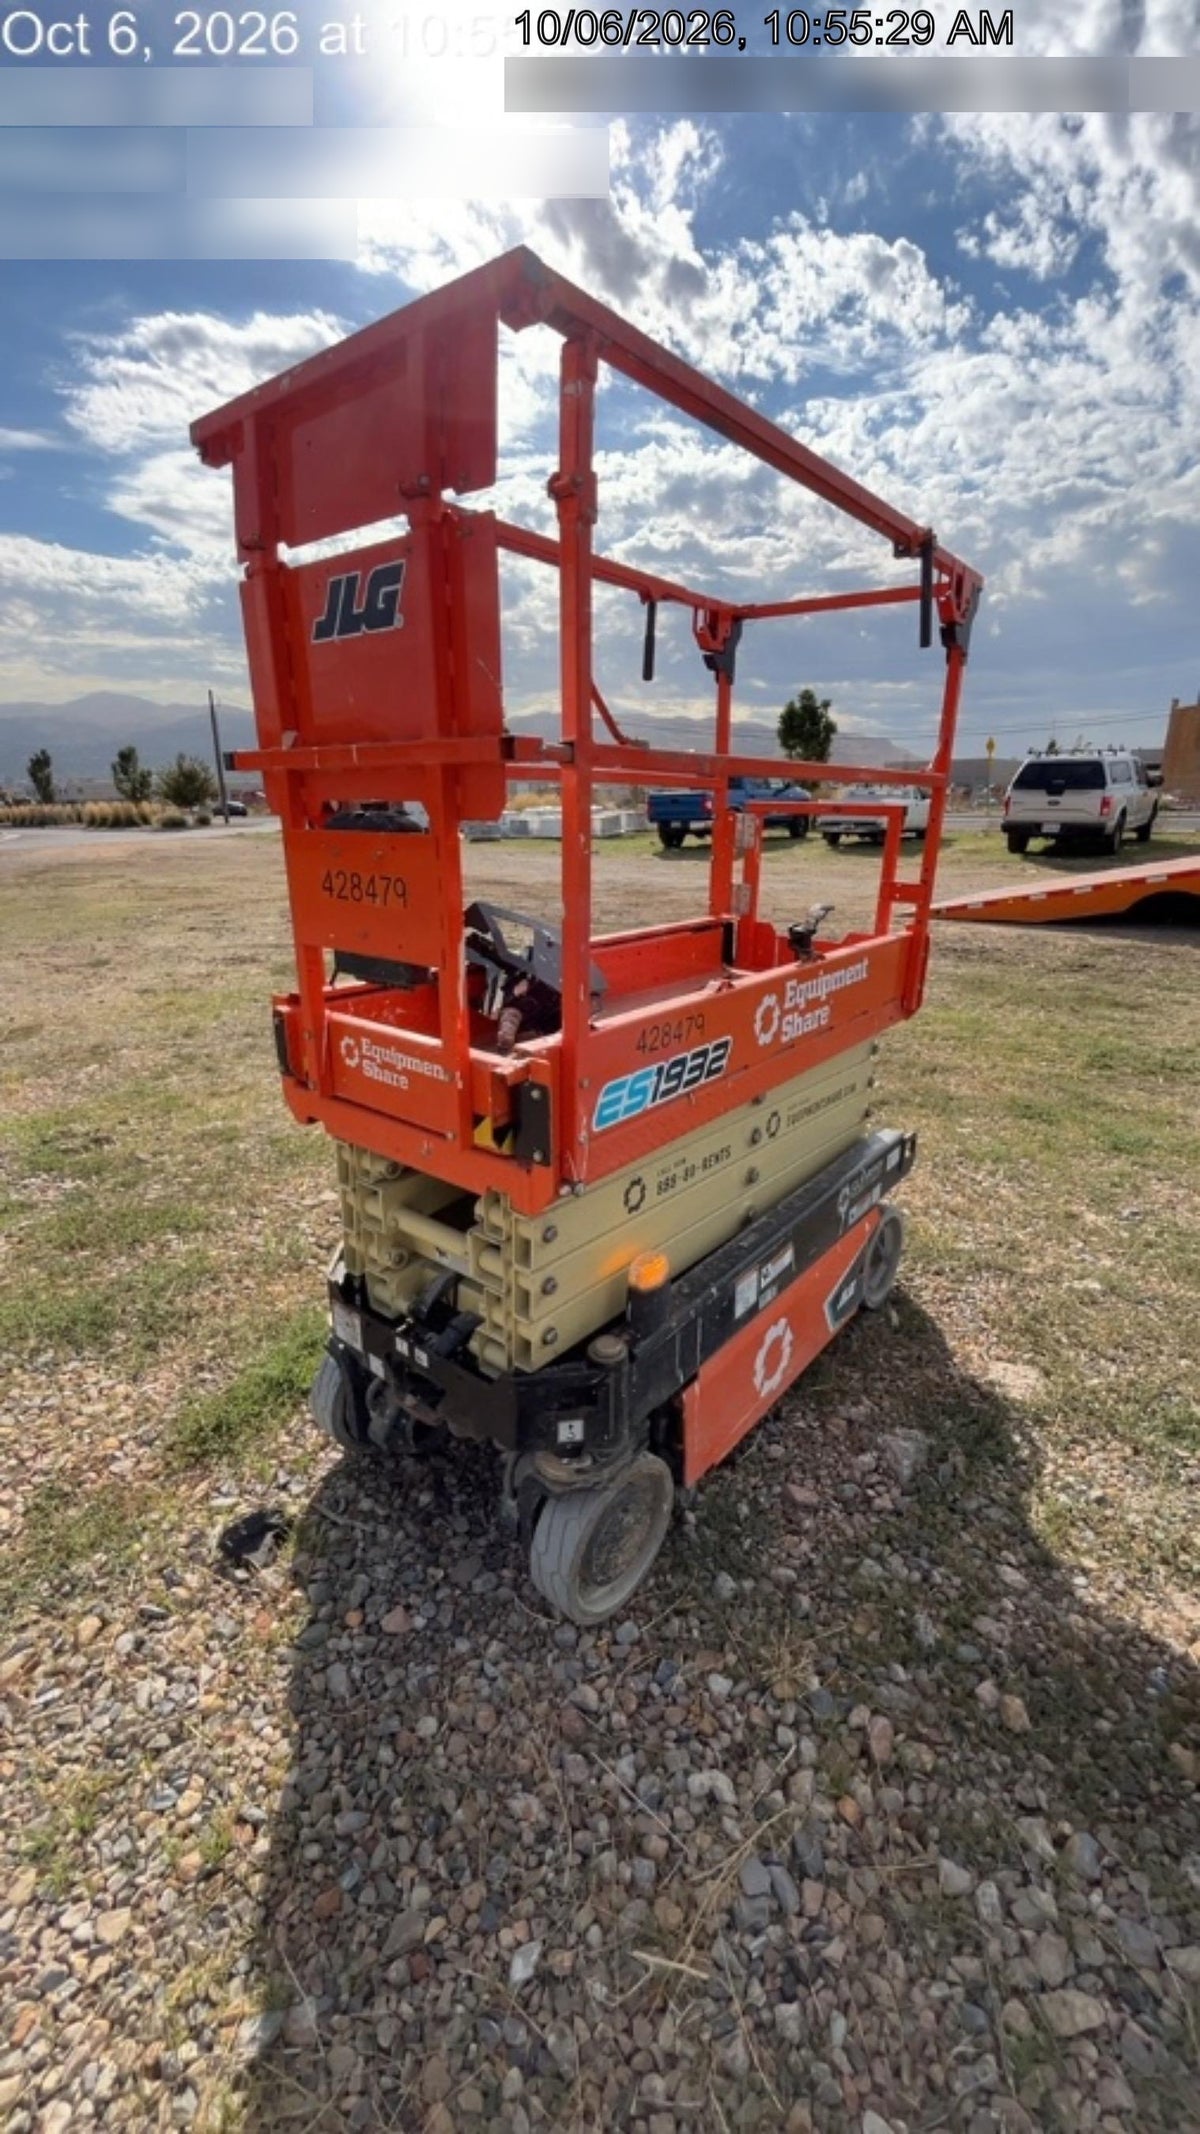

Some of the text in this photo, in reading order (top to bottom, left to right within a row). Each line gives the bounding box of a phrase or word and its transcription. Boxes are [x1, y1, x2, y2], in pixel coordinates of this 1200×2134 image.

[312, 560, 405, 643] JLG
[322, 868, 407, 909] 428479
[784, 957, 870, 1009] Equipment
[635, 1013, 706, 1055] 428479
[781, 1005, 831, 1044] Share
[361, 1036, 451, 1082] Equipmen
[361, 1058, 409, 1090] Share
[592, 1035, 734, 1132] ES1932
